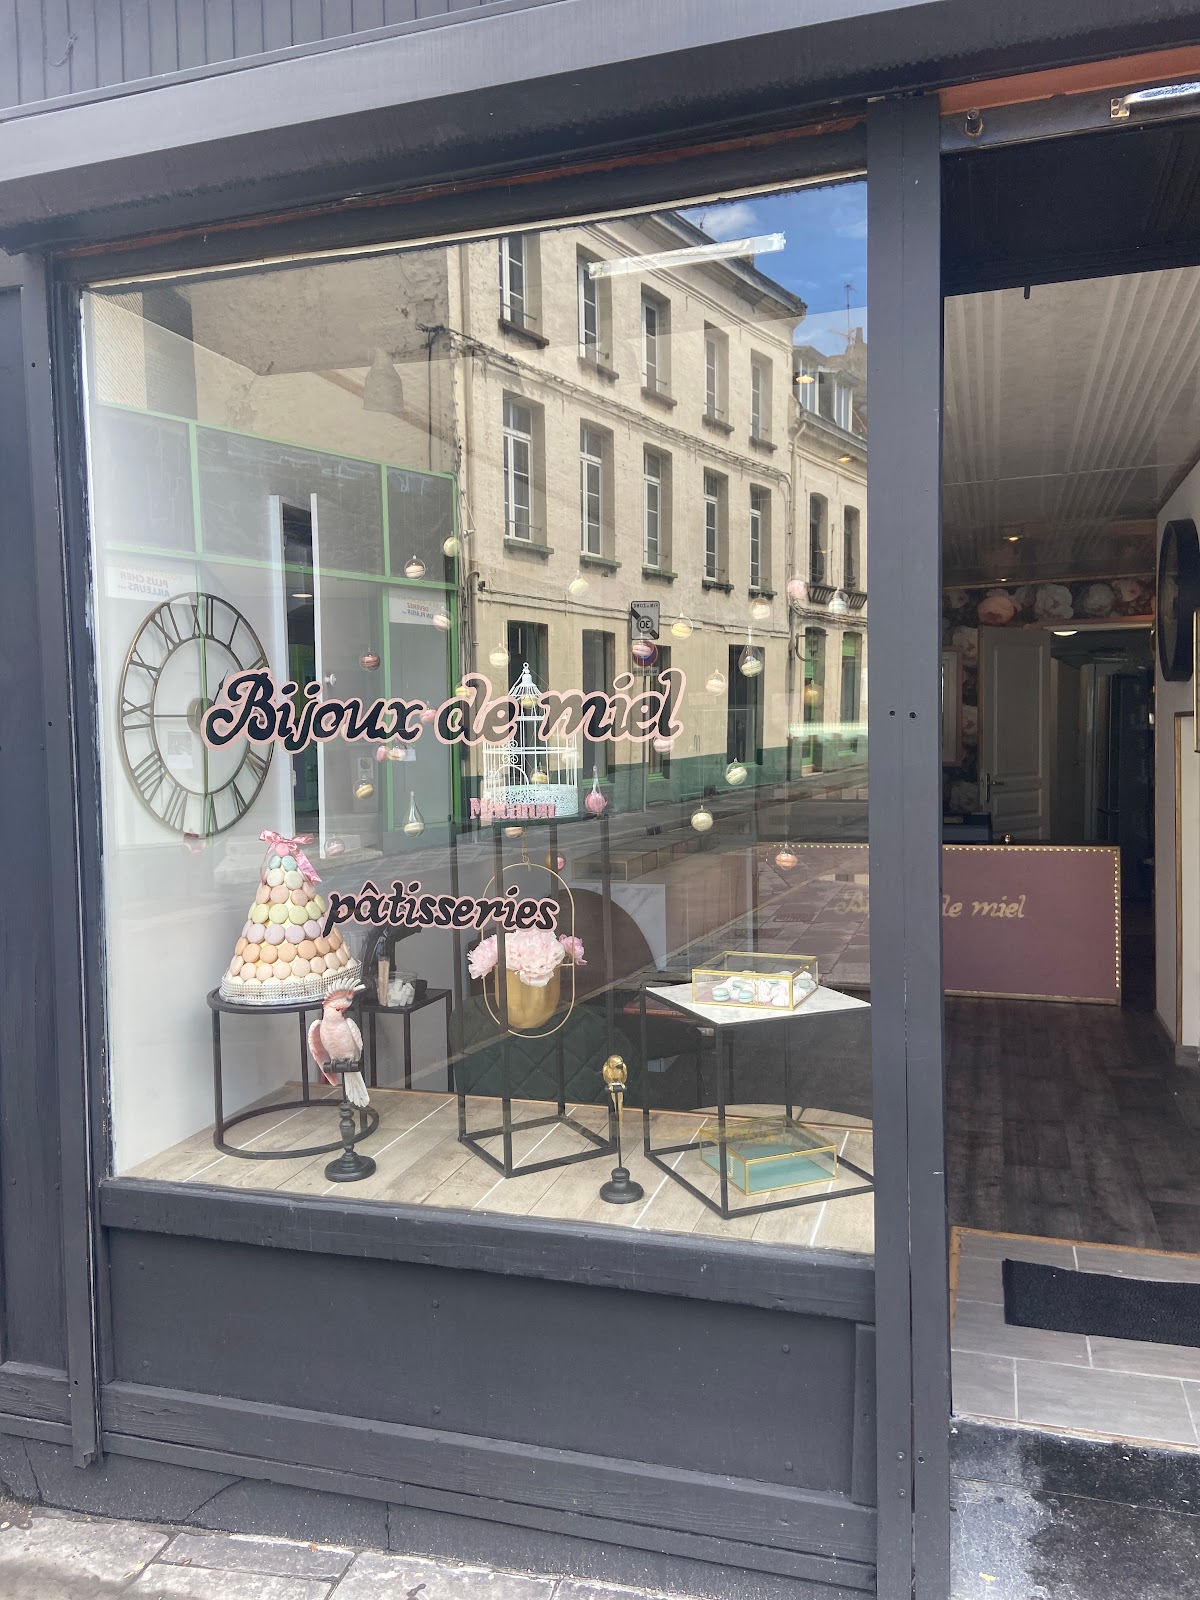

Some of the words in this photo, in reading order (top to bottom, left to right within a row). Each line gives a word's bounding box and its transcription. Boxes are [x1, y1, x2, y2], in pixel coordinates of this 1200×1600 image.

[201, 667, 428, 754] Bijoux
[434, 672, 521, 746] de
[534, 668, 687, 744] miel
[320, 880, 561, 939] pâtisseries
[971, 894, 1027, 918] miel
